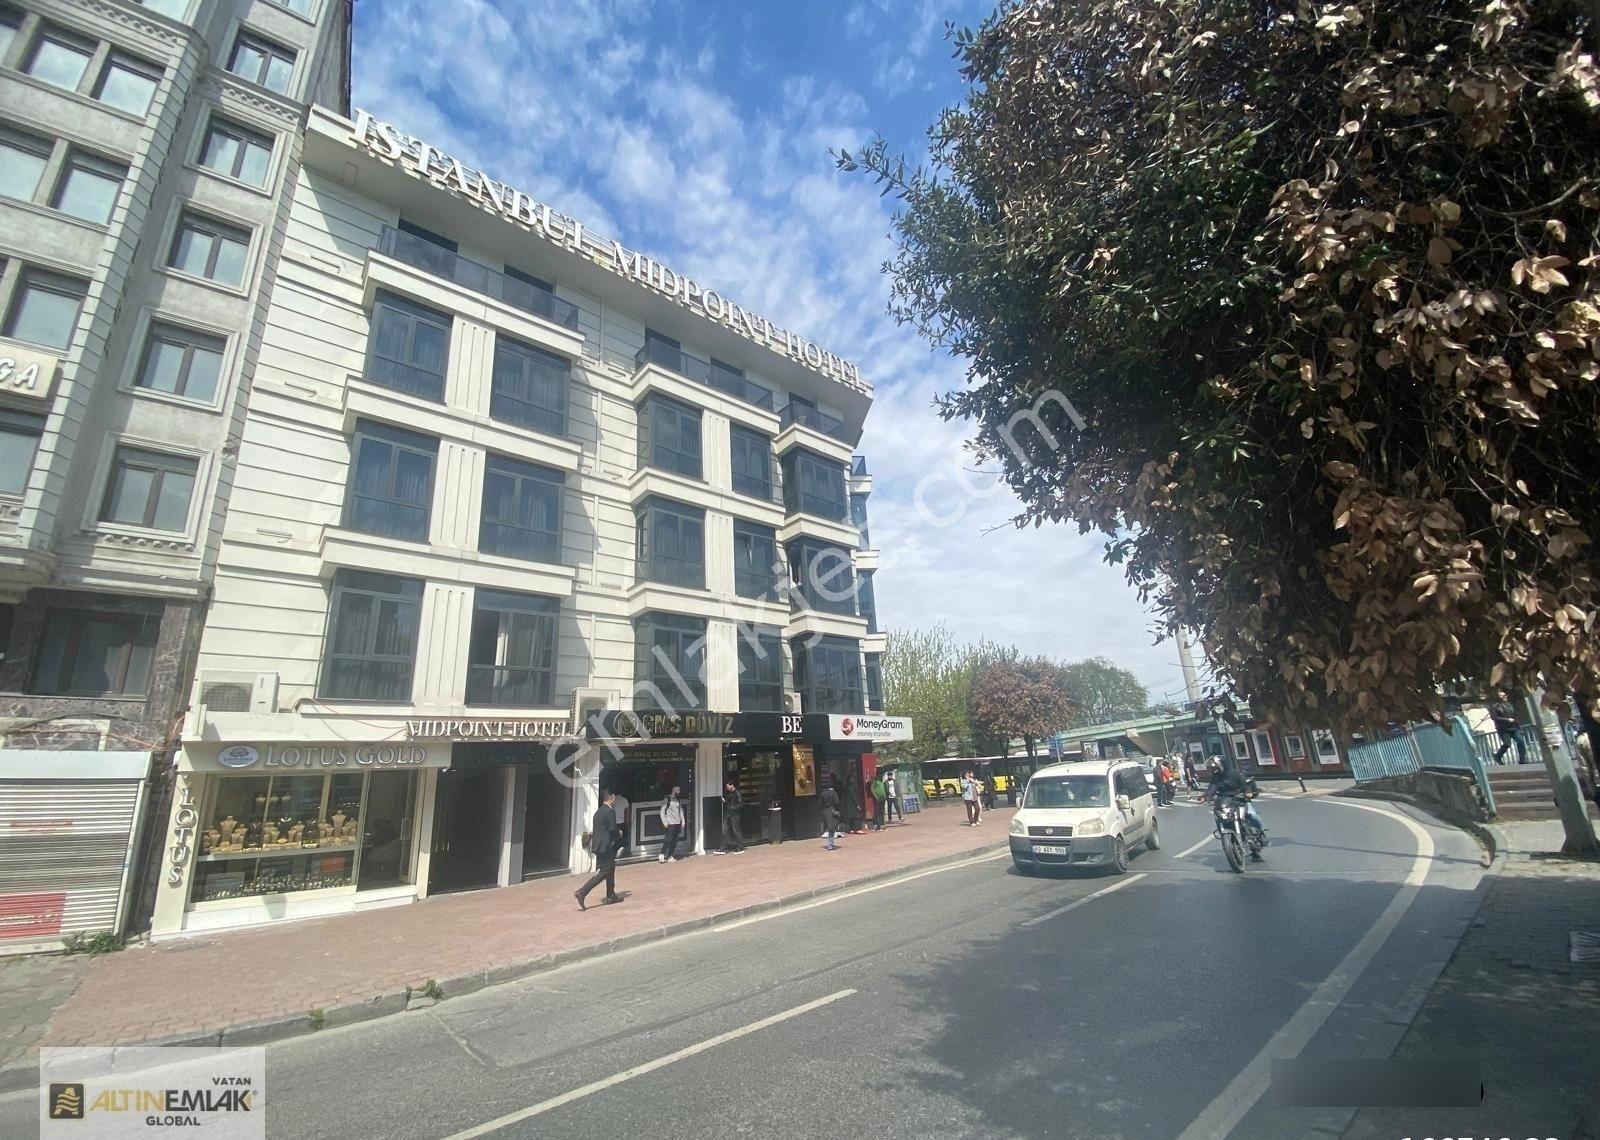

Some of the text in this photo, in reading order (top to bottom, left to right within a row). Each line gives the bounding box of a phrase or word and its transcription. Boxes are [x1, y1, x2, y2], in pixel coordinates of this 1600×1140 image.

[348, 107, 869, 393] ISTANBUL MIDPOINT HOTEL
[405, 719, 572, 738] MIDPOINT HOTEL
[781, 715, 803, 734] BE
[856, 718, 903, 731] MoneyGram
[265, 744, 426, 767] LOTUS GOLD
[168, 788, 194, 883] LOTUS
